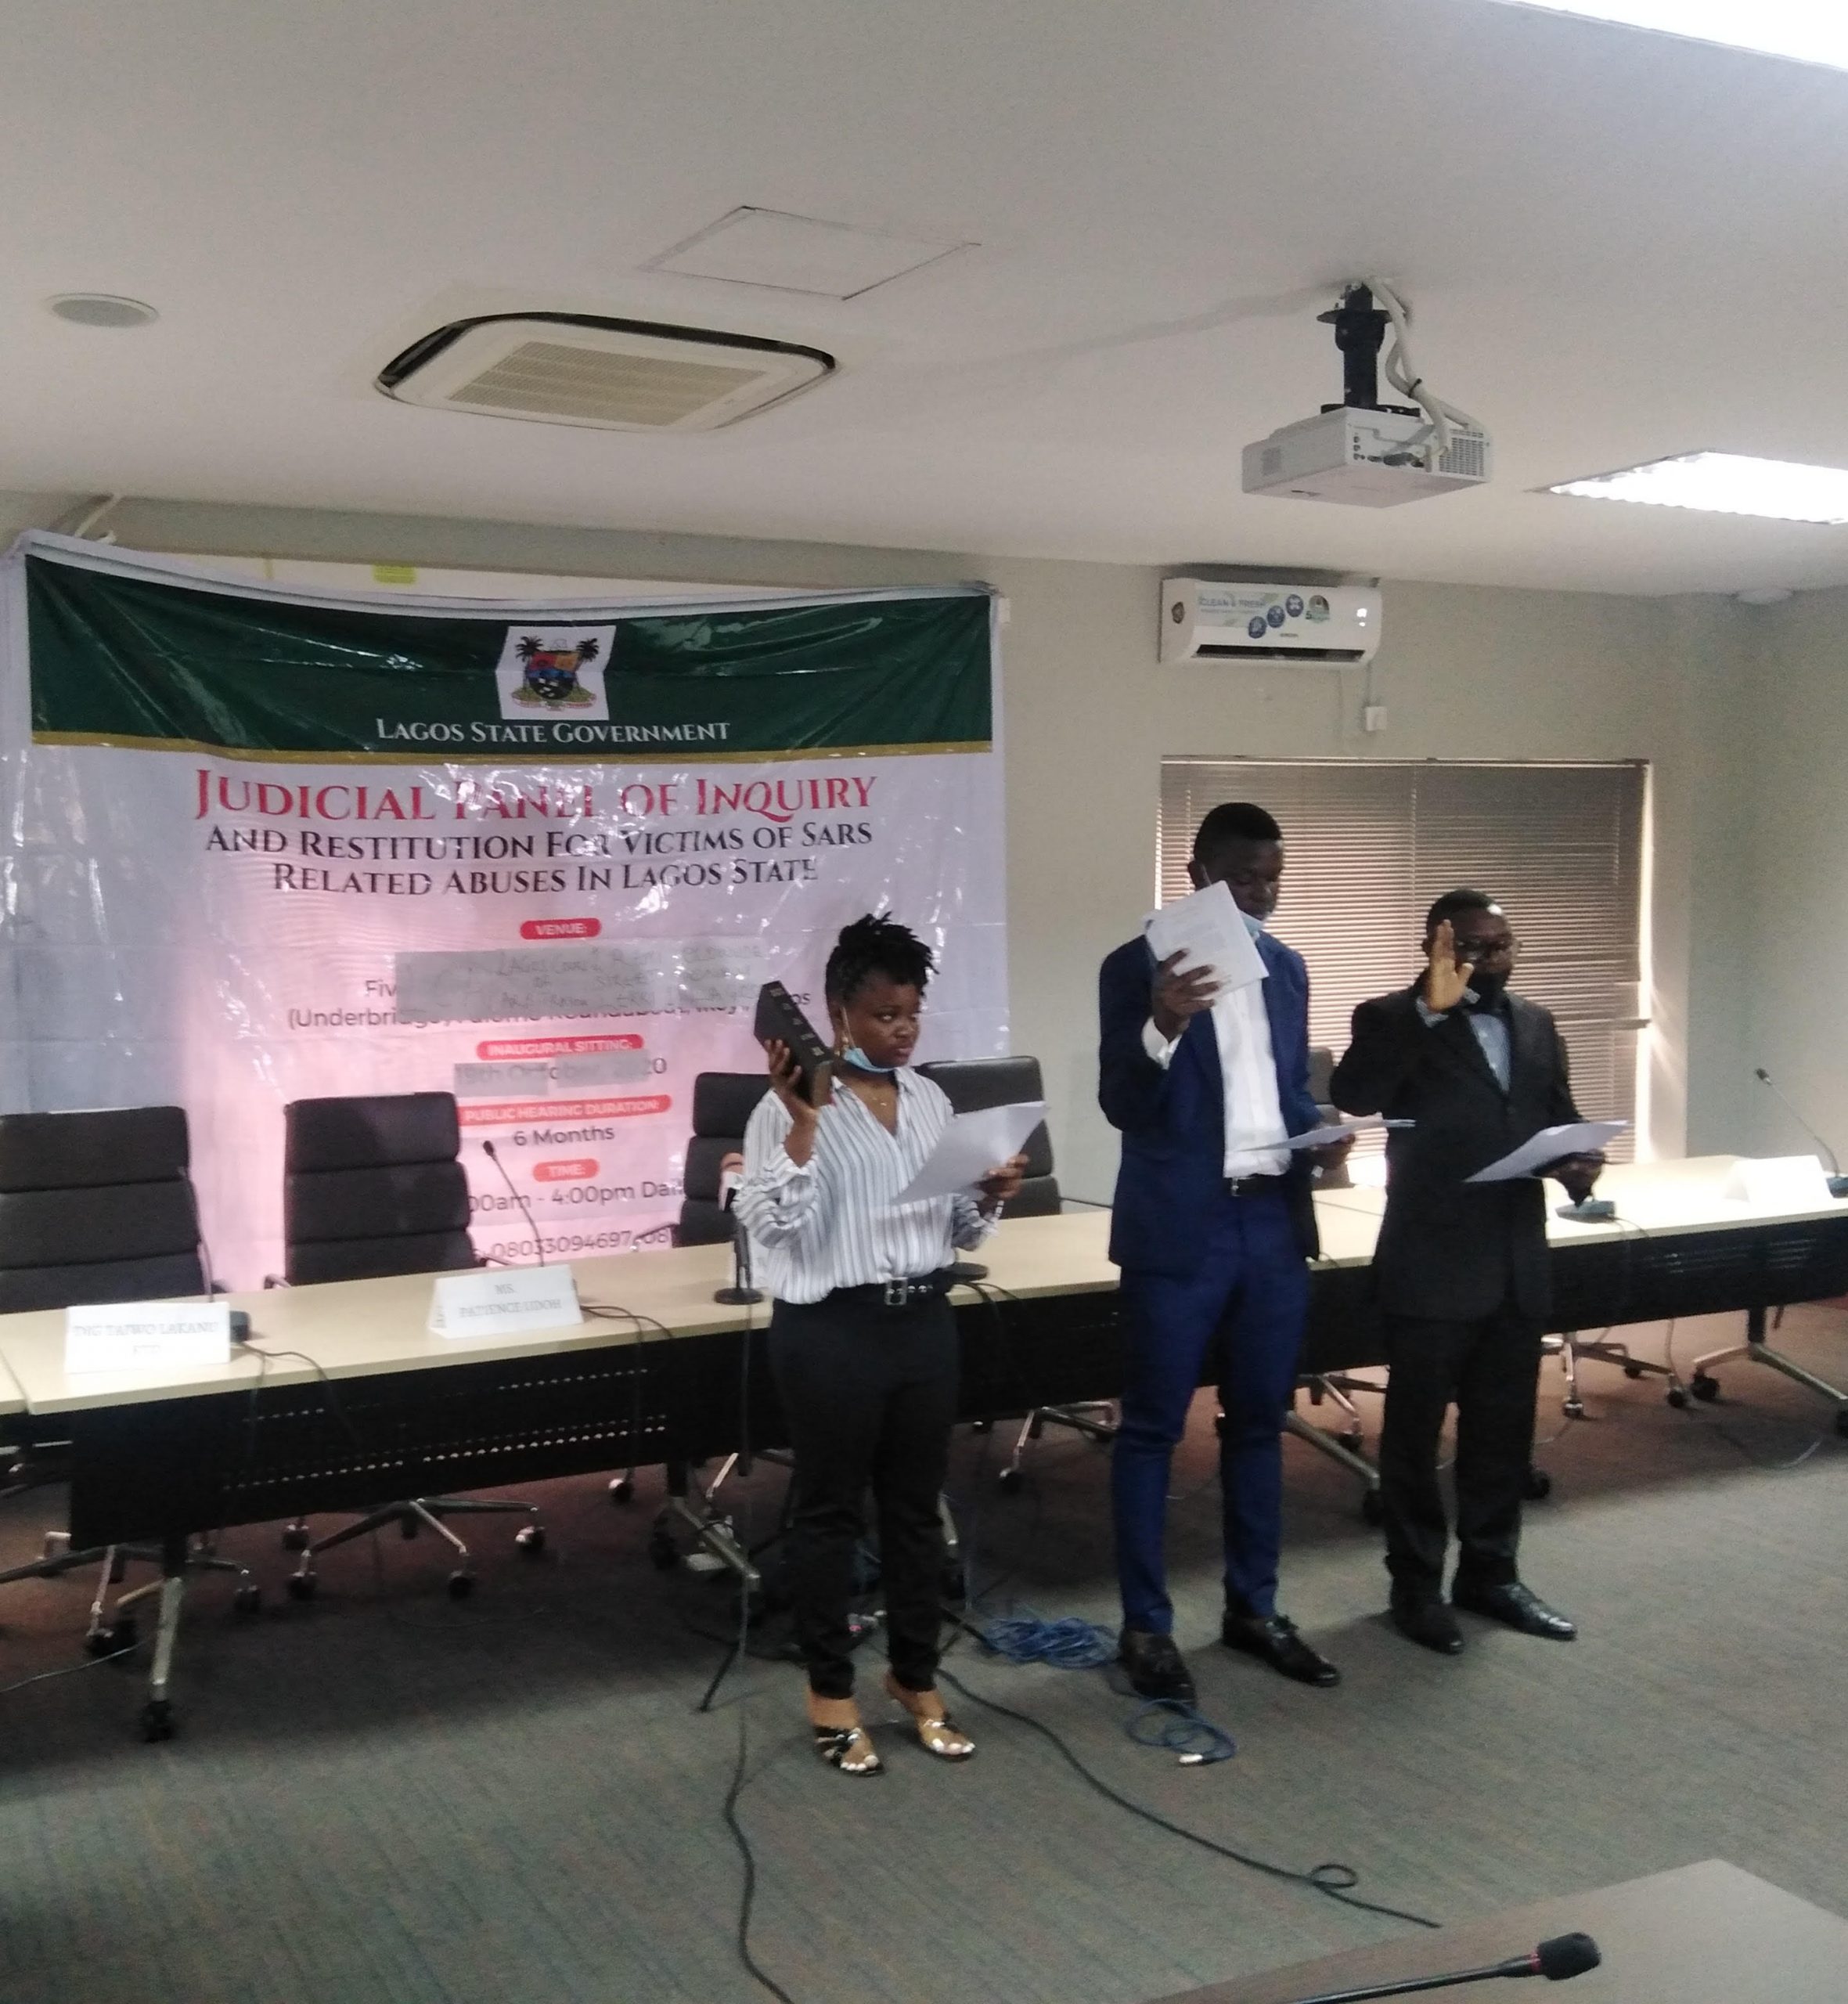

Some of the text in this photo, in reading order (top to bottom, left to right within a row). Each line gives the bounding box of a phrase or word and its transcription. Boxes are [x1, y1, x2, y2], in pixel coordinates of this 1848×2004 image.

[376, 718, 731, 743] LAGOS STATE GOVERNMENT
[194, 769, 437, 820] JUDICIAL
[620, 783, 679, 817] OF
[695, 775, 878, 824] INQUIRY
[205, 822, 873, 860] AND RESTITUTION FOR VICTIMS OF SARS
[273, 858, 820, 896] RELATED ABUSES IN LAGOS STATE
[535, 922, 586, 935] VENUE:
[365, 979, 397, 997] Fiv
[486, 1043, 572, 1057] INAUGURAL
[463, 1099, 660, 1122] PUBLIC HEARING DURATION:
[513, 1126, 615, 1146] 6 Months
[547, 1163, 586, 1177] TIME:
[551, 1185, 636, 1206] 4:00pm
[457, 1301, 521, 1318] PATIENCE
